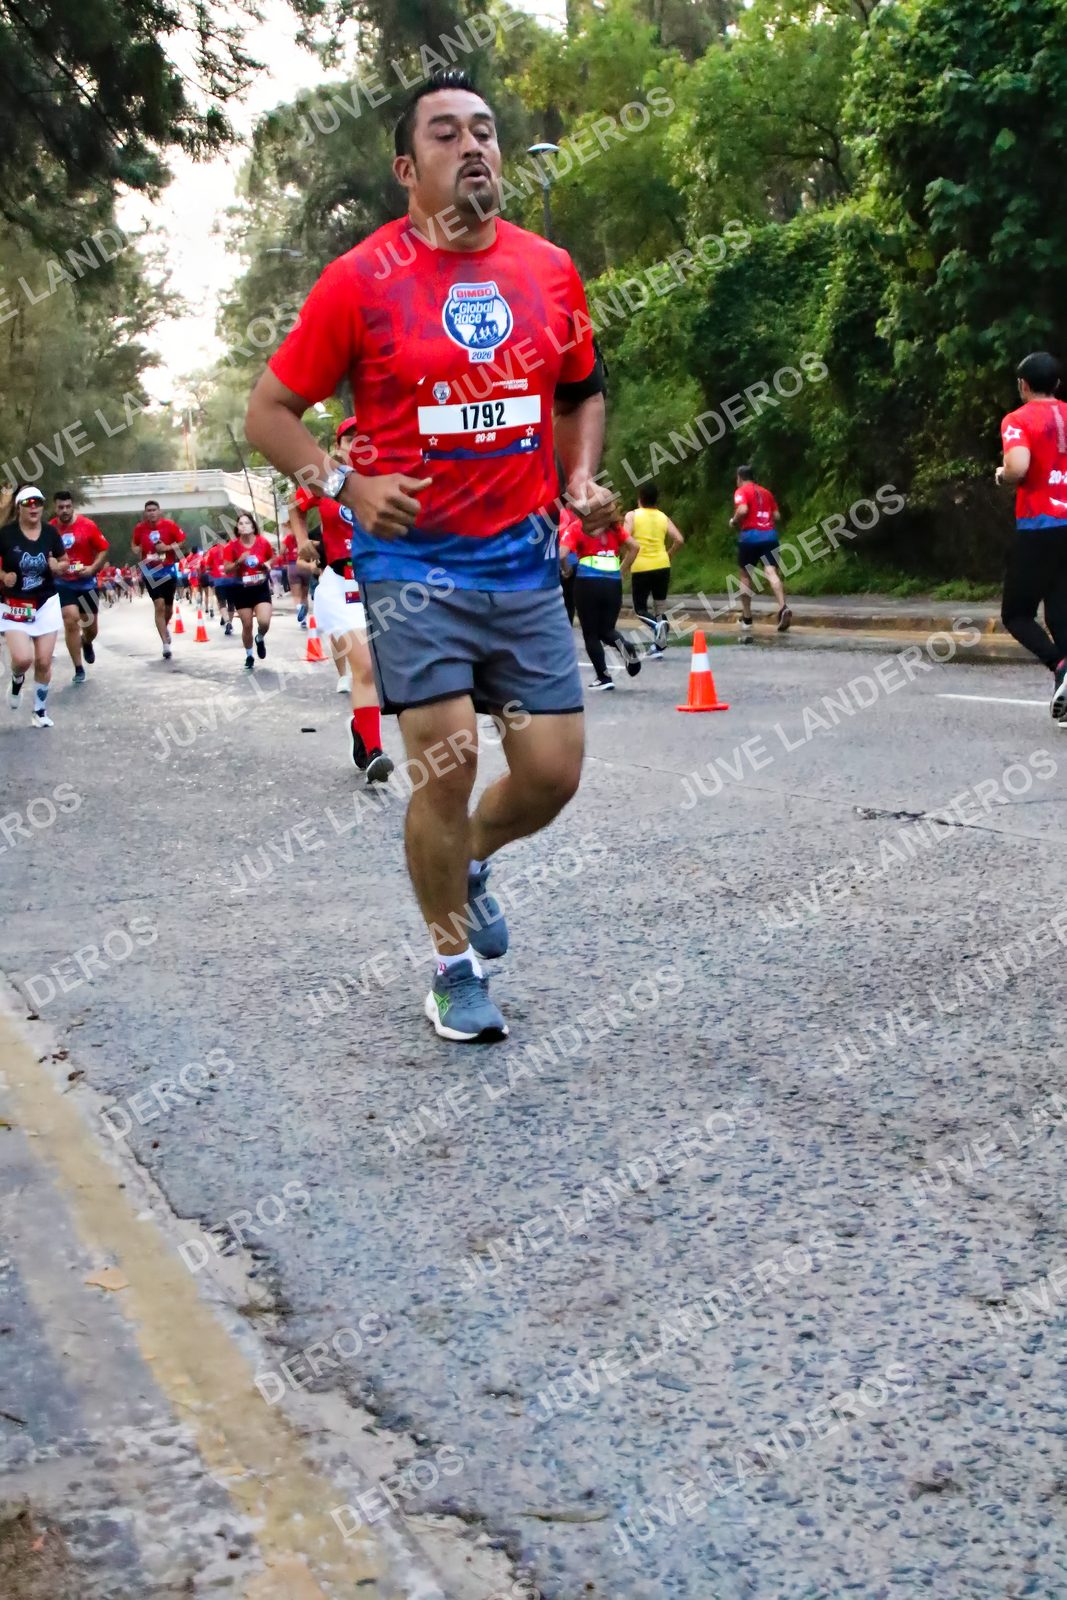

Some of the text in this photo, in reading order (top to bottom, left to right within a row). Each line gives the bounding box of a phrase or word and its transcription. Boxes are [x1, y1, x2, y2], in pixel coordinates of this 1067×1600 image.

[456, 288, 492, 298] BIMBO
[460, 301, 494, 314] Global
[453, 312, 482, 325] Race
[460, 401, 506, 430] 1792
